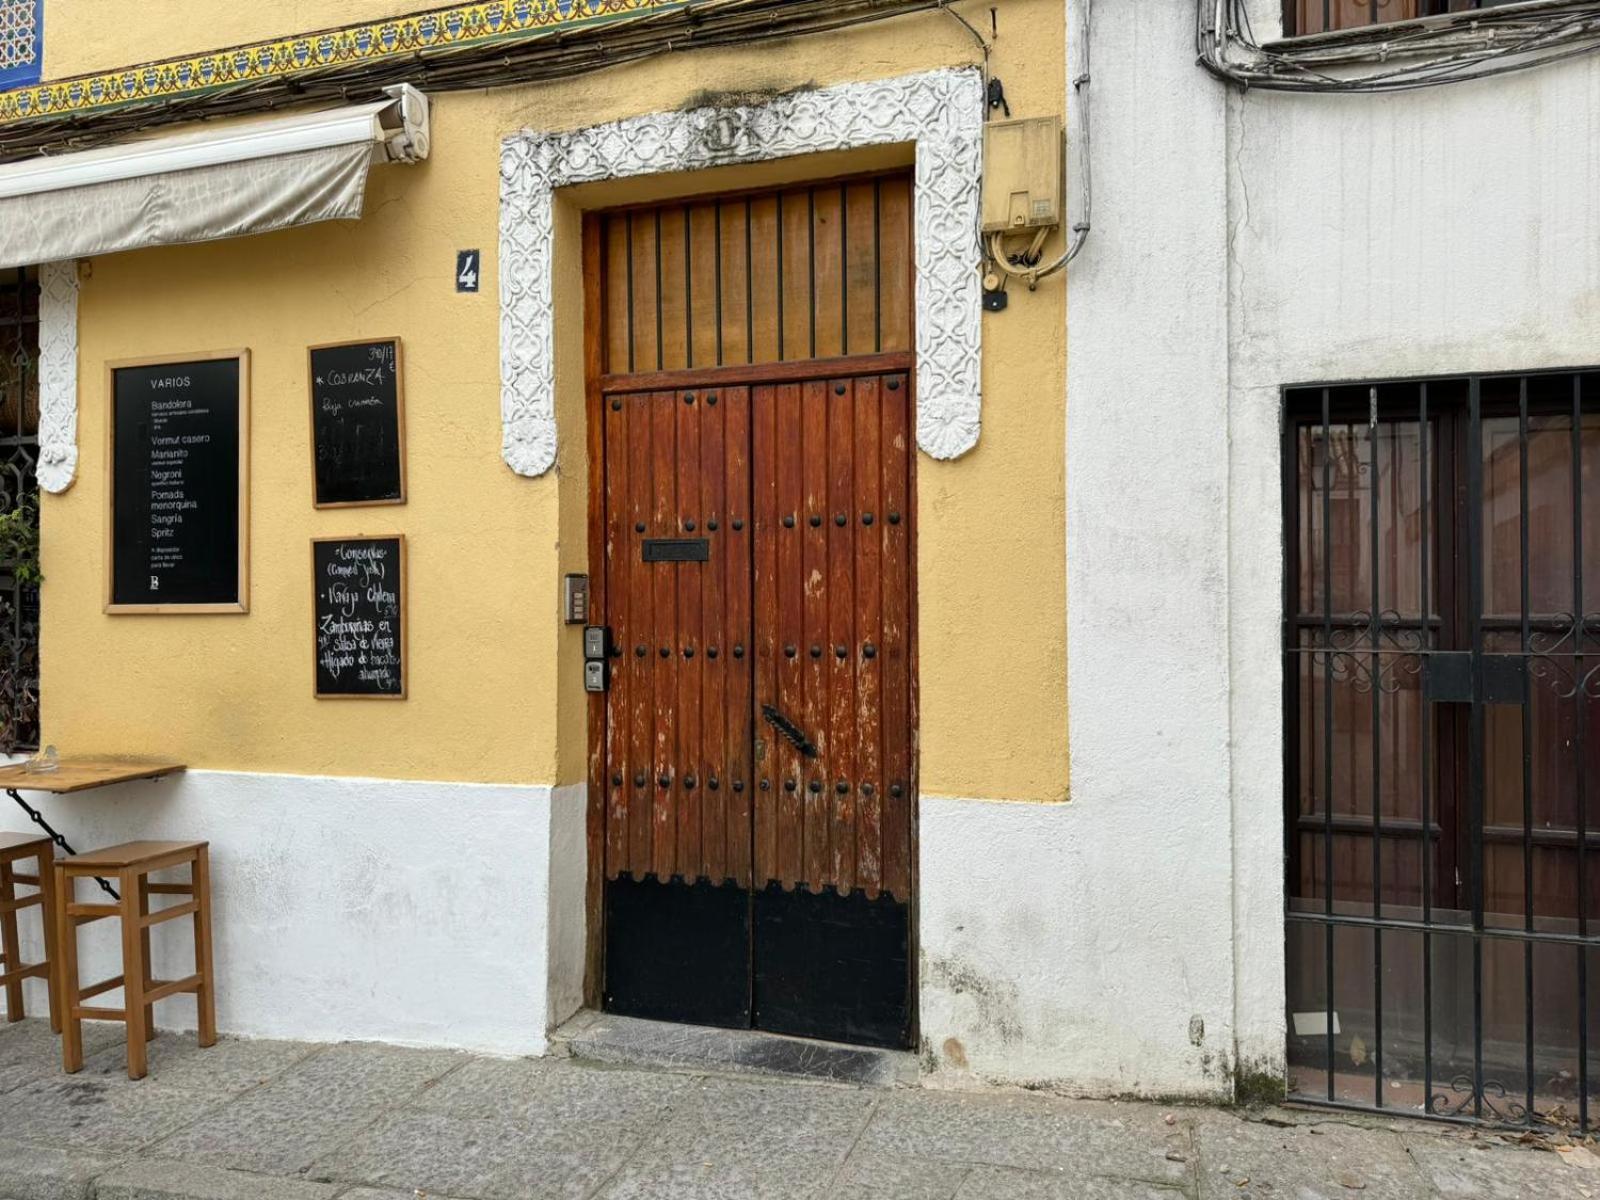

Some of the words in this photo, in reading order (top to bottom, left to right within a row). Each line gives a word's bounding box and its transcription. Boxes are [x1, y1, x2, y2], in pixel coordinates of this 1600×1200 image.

[459, 255, 476, 287] 4
[150, 376, 191, 389] VARIOS
[151, 399, 192, 410] Bandolera
[151, 436, 181, 446] Vermut
[181, 434, 210, 445] casero
[151, 450, 189, 460] Marianito
[151, 468, 182, 481] Negroni
[151, 490, 185, 500] Pomada
[151, 500, 198, 511] menorquina
[151, 527, 175, 539] Spritz
[378, 620, 392, 633] en
